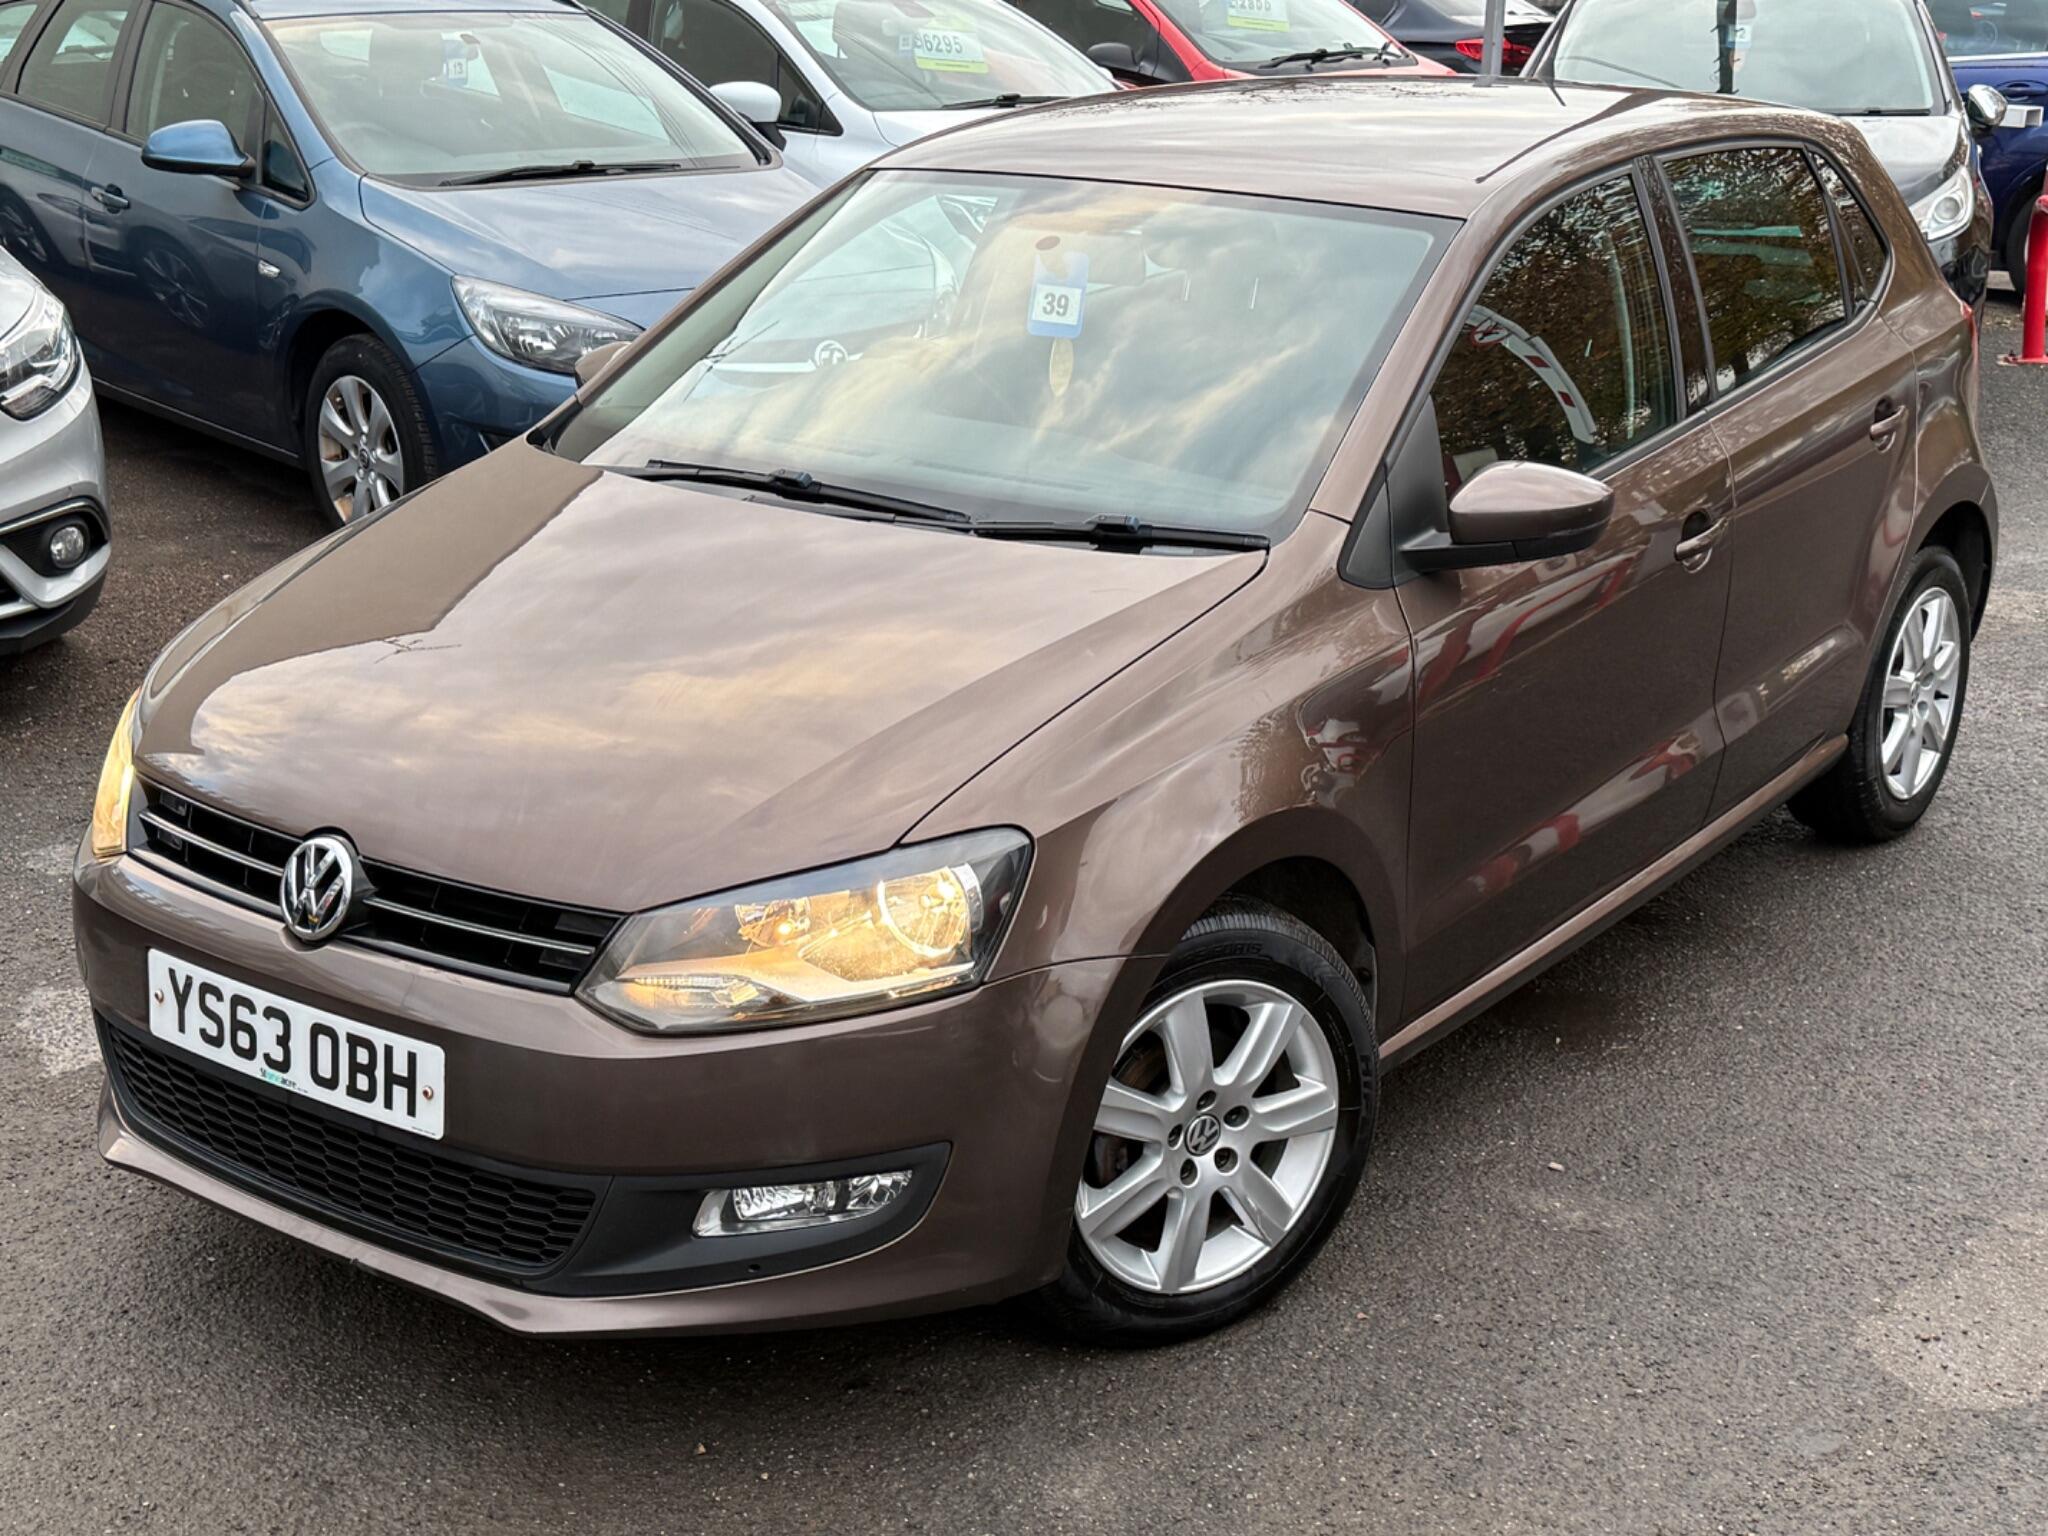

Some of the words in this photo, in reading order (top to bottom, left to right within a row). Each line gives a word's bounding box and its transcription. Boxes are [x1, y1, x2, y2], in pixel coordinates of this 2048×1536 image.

[1042, 293, 1069, 317] 39
[280, 834, 352, 940] VW
[168, 967, 292, 1075] YS63
[309, 1021, 417, 1119] OBH
[1186, 1114, 1221, 1156] VW
